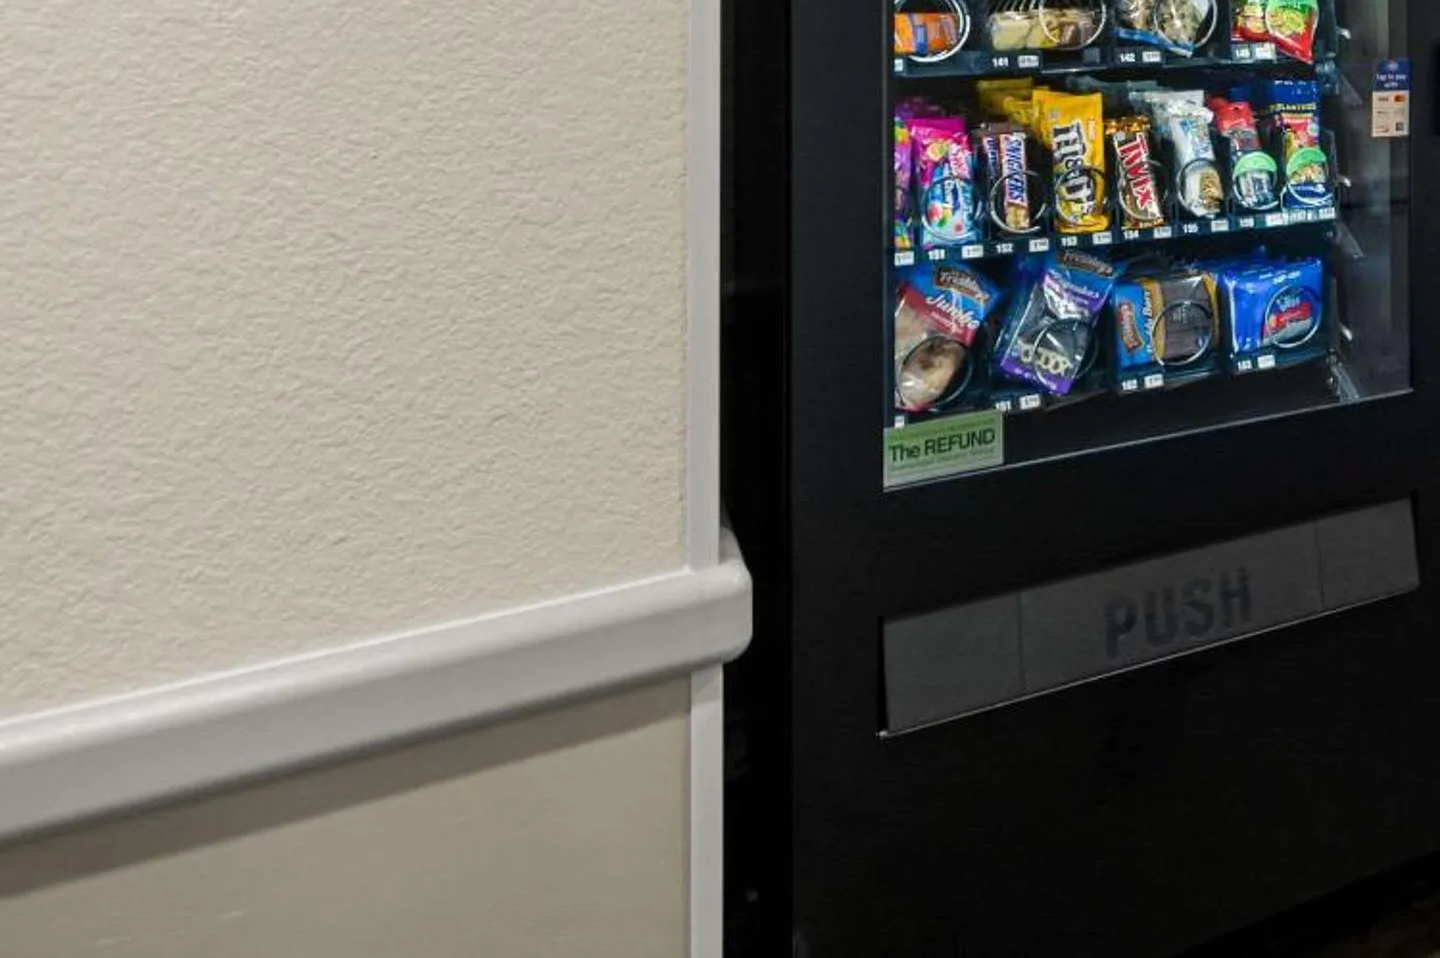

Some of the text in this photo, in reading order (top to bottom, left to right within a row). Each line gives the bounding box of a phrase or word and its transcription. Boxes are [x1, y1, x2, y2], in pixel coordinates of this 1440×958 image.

[1118, 132, 1154, 209] TWIX
[925, 293, 980, 330] Jumbo
[887, 442, 921, 462] The
[924, 428, 996, 456] REFUND
[1104, 567, 1251, 659] PUSH
